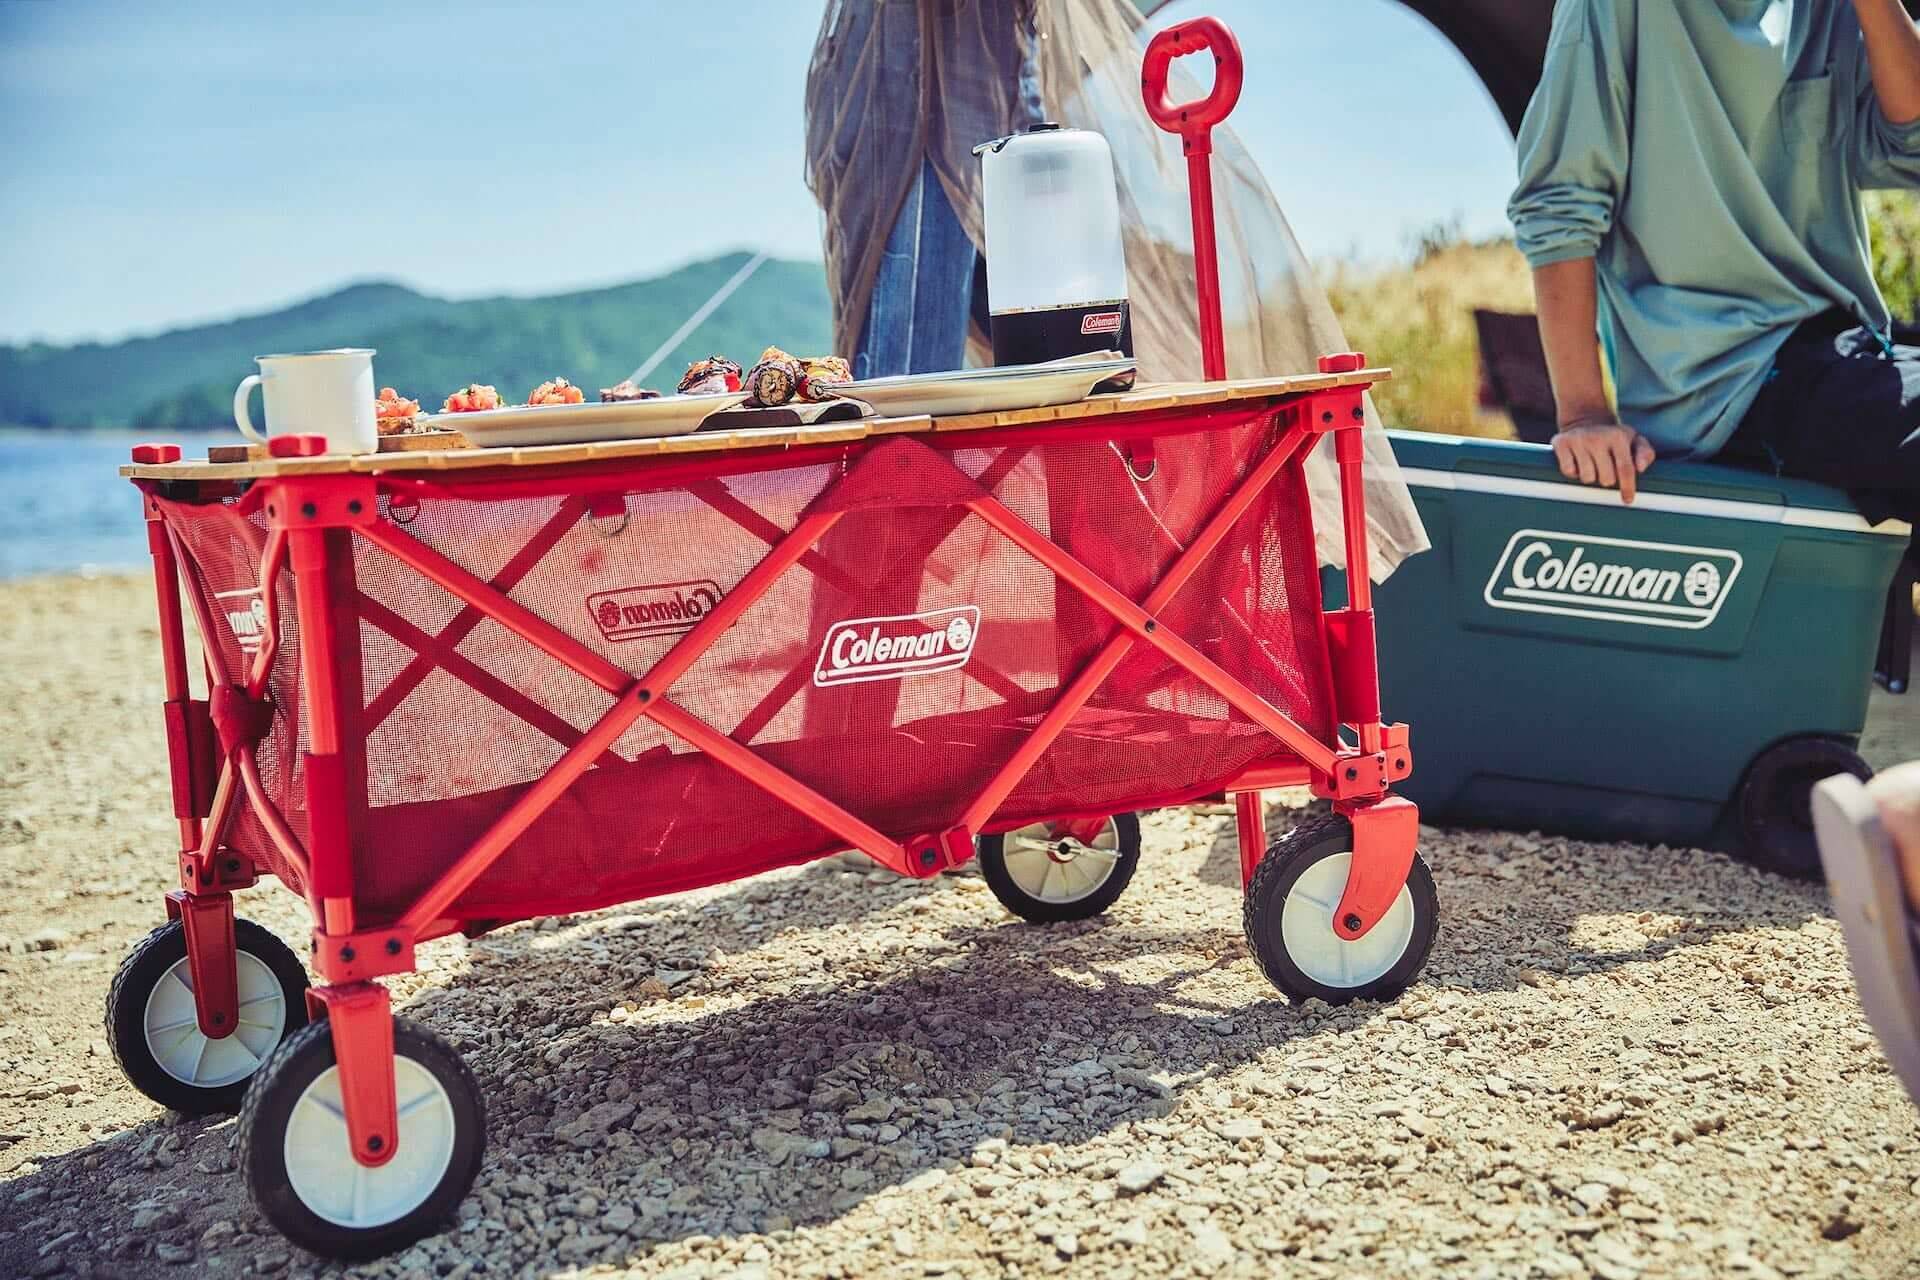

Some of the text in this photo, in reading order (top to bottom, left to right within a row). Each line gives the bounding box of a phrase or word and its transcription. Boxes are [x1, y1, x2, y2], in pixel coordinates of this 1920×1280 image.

[1085, 316, 1116, 329] Coleman
[1512, 541, 1682, 602] Coleman
[831, 627, 946, 669] Coleman
